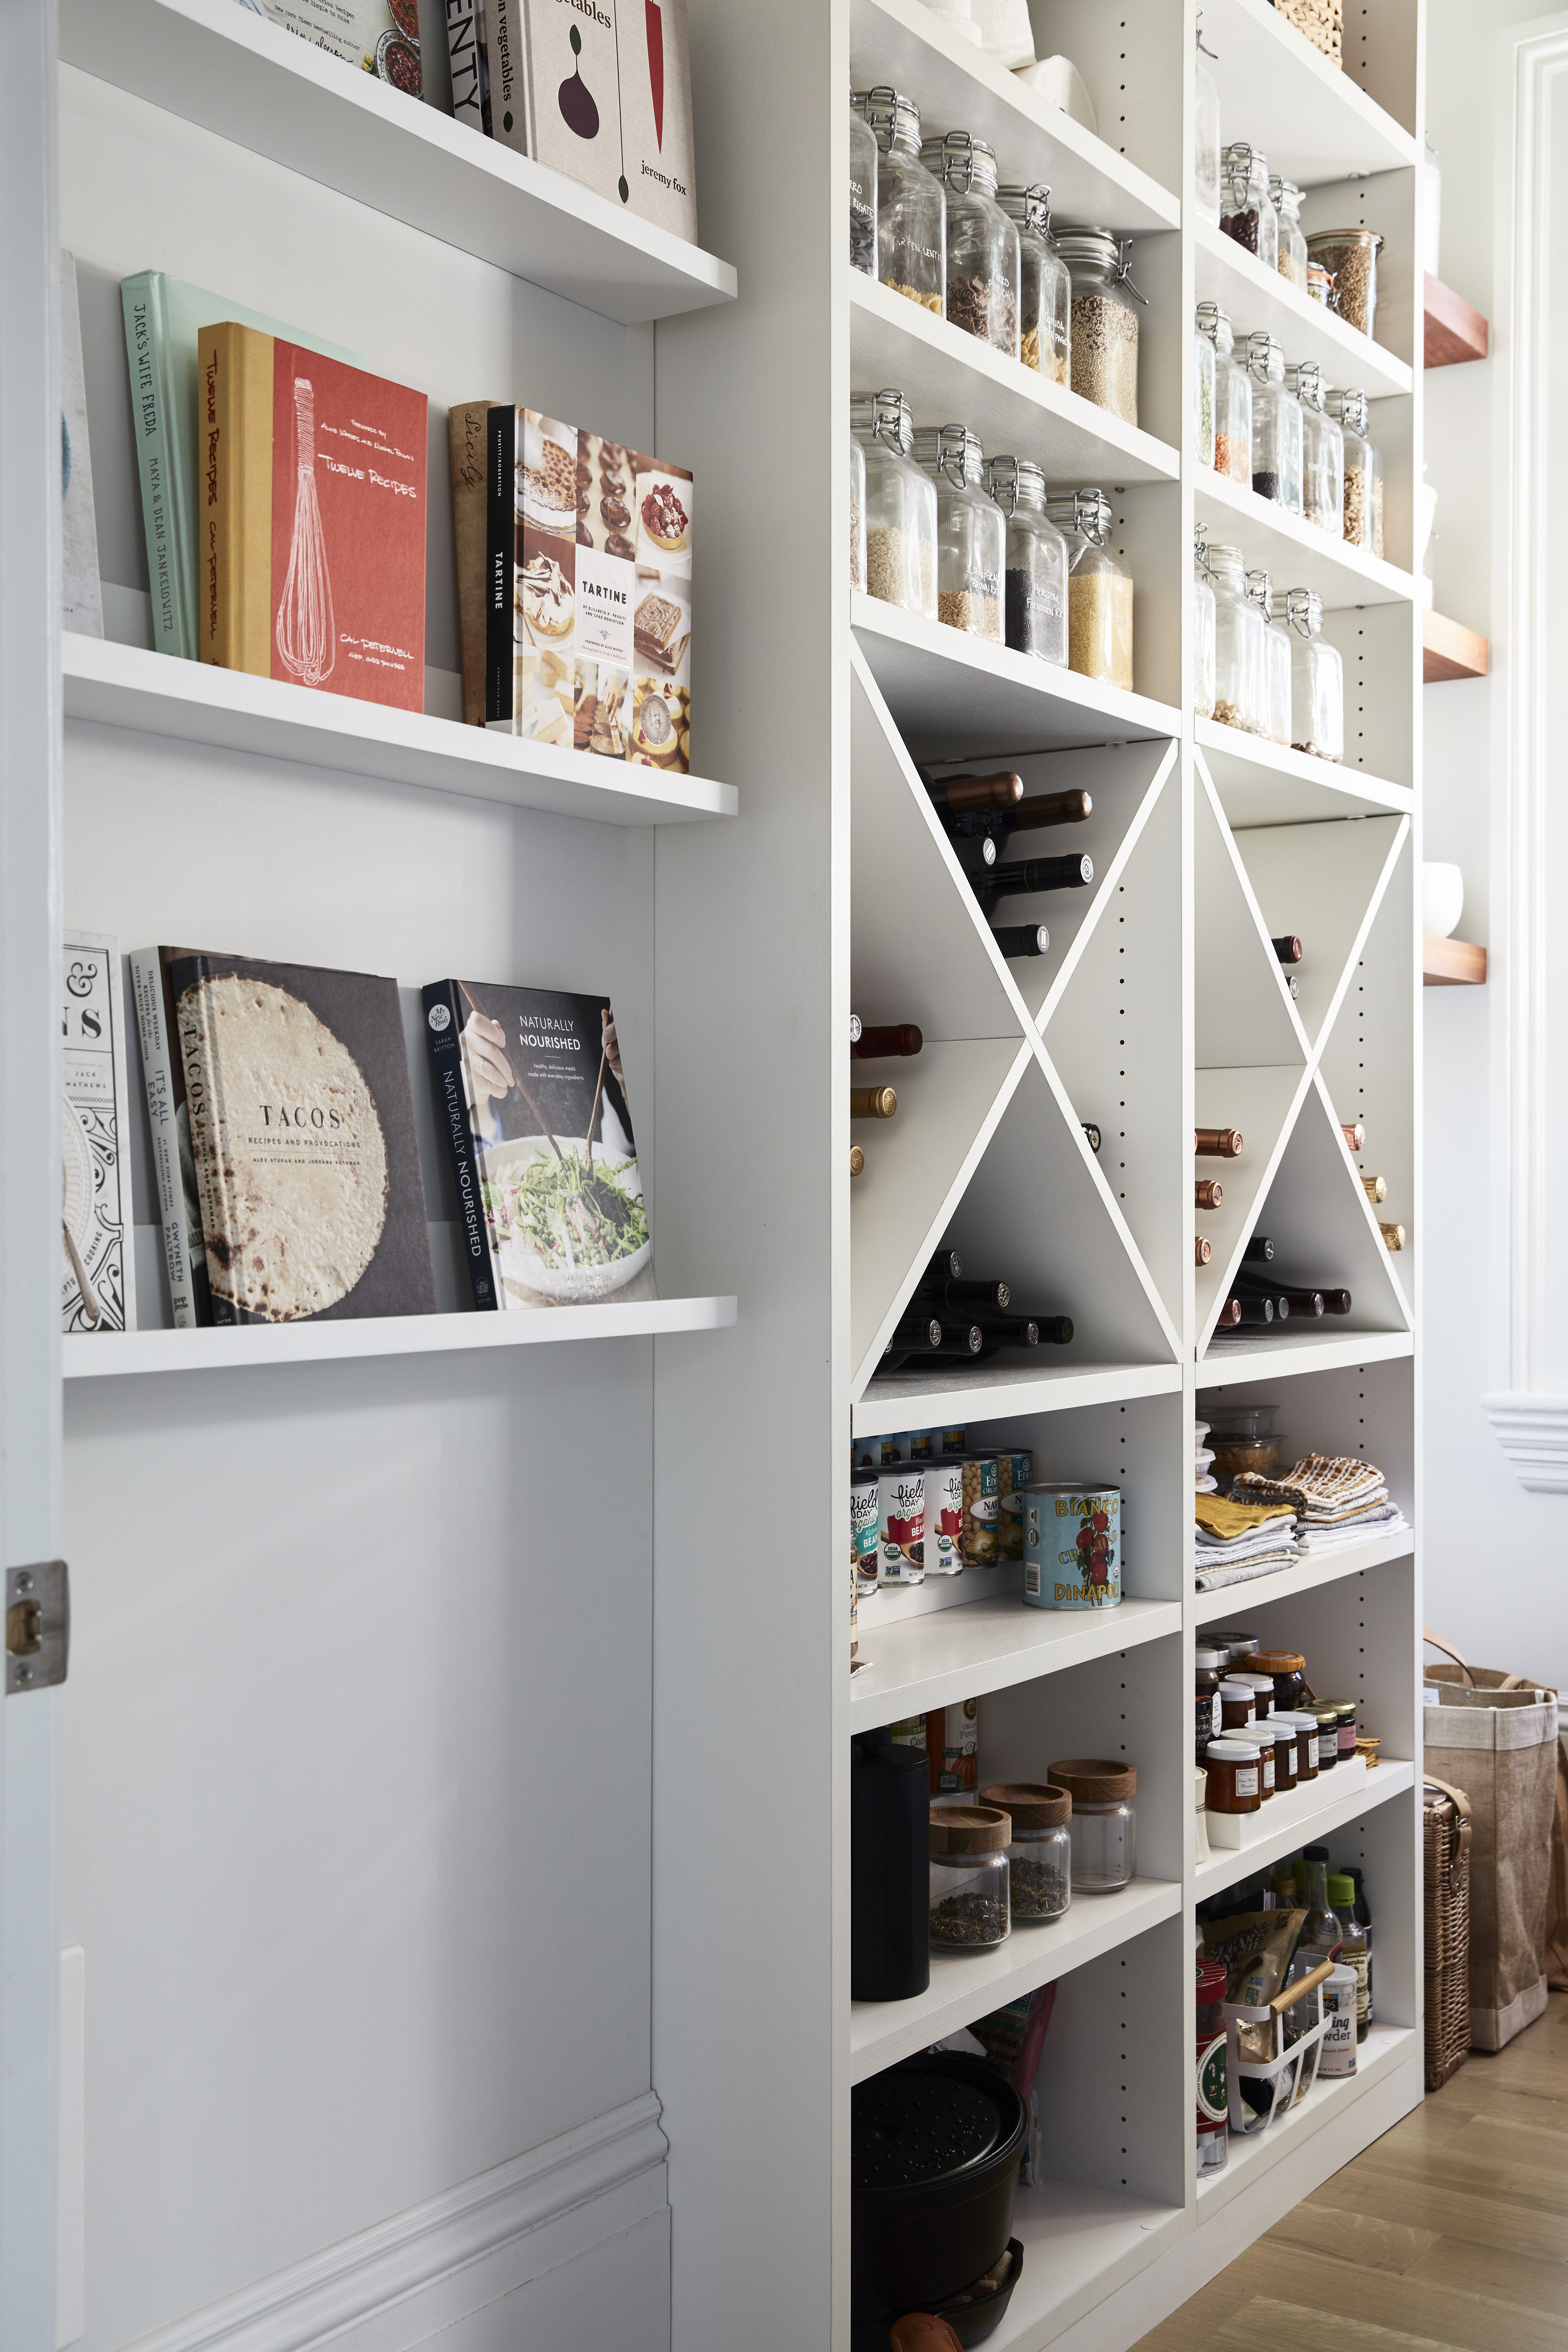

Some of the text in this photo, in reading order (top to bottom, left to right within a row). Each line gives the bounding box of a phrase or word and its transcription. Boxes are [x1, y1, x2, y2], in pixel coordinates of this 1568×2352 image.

[310, 1, 328, 13] Simple
[337, 14, 350, 24] Make
[335, 5, 355, 19] Recipes
[274, 4, 360, 51] New York Times bestselling author
[498, 16, 514, 101] vegetables
[641, 160, 686, 196] jeremy fox
[853, 198, 875, 218] RIGATE
[992, 269, 1009, 287] FARRO
[135, 303, 157, 437] JACK'S WIFE FREDA
[205, 350, 219, 505] TWELVE RECIPES
[379, 430, 386, 439] BY
[321, 423, 338, 434] ALICE
[340, 429, 360, 442] WATERS
[394, 448, 413, 461] POLLAN
[460, 413, 484, 491] Sicily
[318, 454, 417, 498] TWELVE RECIPES
[149, 458, 173, 632] MAYA & DEAN JANKELOWITZ
[207, 554, 219, 640] PETERNELL
[583, 581, 626, 604] TARTINE
[970, 578, 990, 593] BROWN
[1034, 582, 1059, 604] HEIRLOOM
[589, 607, 606, 615] ELISABETH
[605, 617, 624, 625] ROBERTSON
[1027, 598, 1054, 617] FORBIDDEN
[340, 634, 414, 659] CAL PETERNELL
[66, 962, 97, 998] &
[135, 965, 144, 1012] SUPER-BUSY
[148, 970, 161, 1051] DELICIOUS WEEKDAY
[520, 1015, 573, 1031] NATURALLY
[434, 1043, 455, 1053] BRITTON
[436, 1037, 451, 1045] SARAH
[520, 1034, 581, 1050] NOURISHED
[148, 1082, 158, 1117] EASY
[155, 1070, 168, 1126] IT'S ALL
[184, 1025, 206, 1116] TACOS
[207, 1188, 215, 1229] ROTHMAN
[259, 1105, 340, 1129] TACOS
[304, 1140, 361, 1148] PROVOCATIONS
[157, 1137, 165, 1181] BESTSELLING
[443, 1071, 481, 1257] NATURALLY NOURISHED
[84, 1231, 102, 1266] COOKING
[165, 1227, 176, 1282] PALTROW
[172, 1222, 184, 1283] GWYNETH
[173, 1295, 186, 1307] goop
[891, 1479, 925, 1507] field
[1055, 1498, 1119, 1517] BIANCO
[1054, 1582, 1119, 1601] DiNAPOLI
